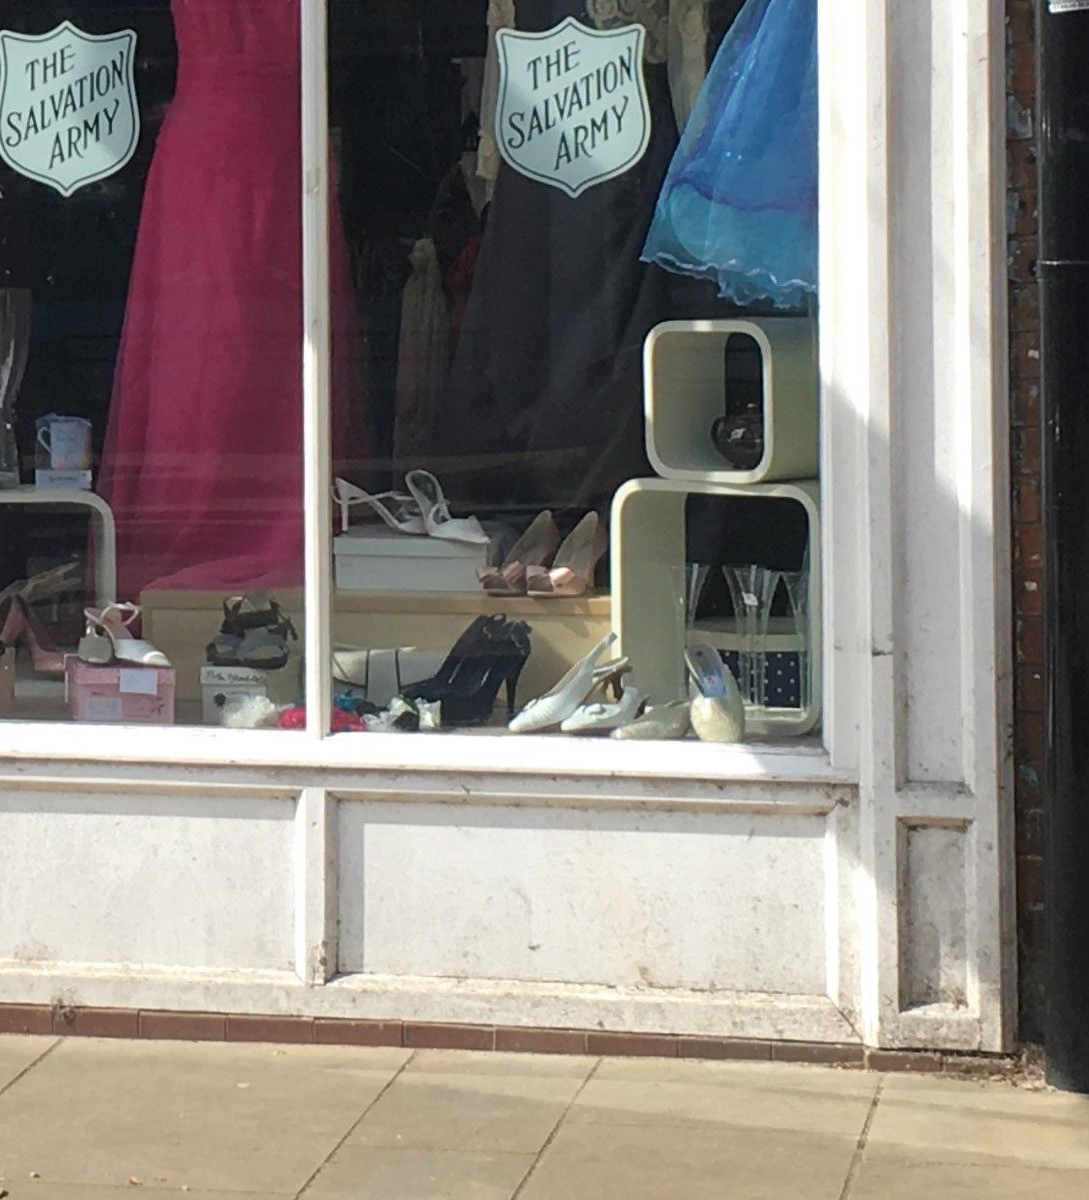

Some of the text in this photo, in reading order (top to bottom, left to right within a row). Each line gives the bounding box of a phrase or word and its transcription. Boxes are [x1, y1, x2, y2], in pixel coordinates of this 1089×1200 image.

[5, 50, 125, 148] SALVATION
[25, 44, 76, 92] THE
[507, 45, 633, 149] SALVATION
[525, 40, 582, 91] THE
[47, 98, 120, 170] ARMY
[552, 95, 629, 172] ARMY
